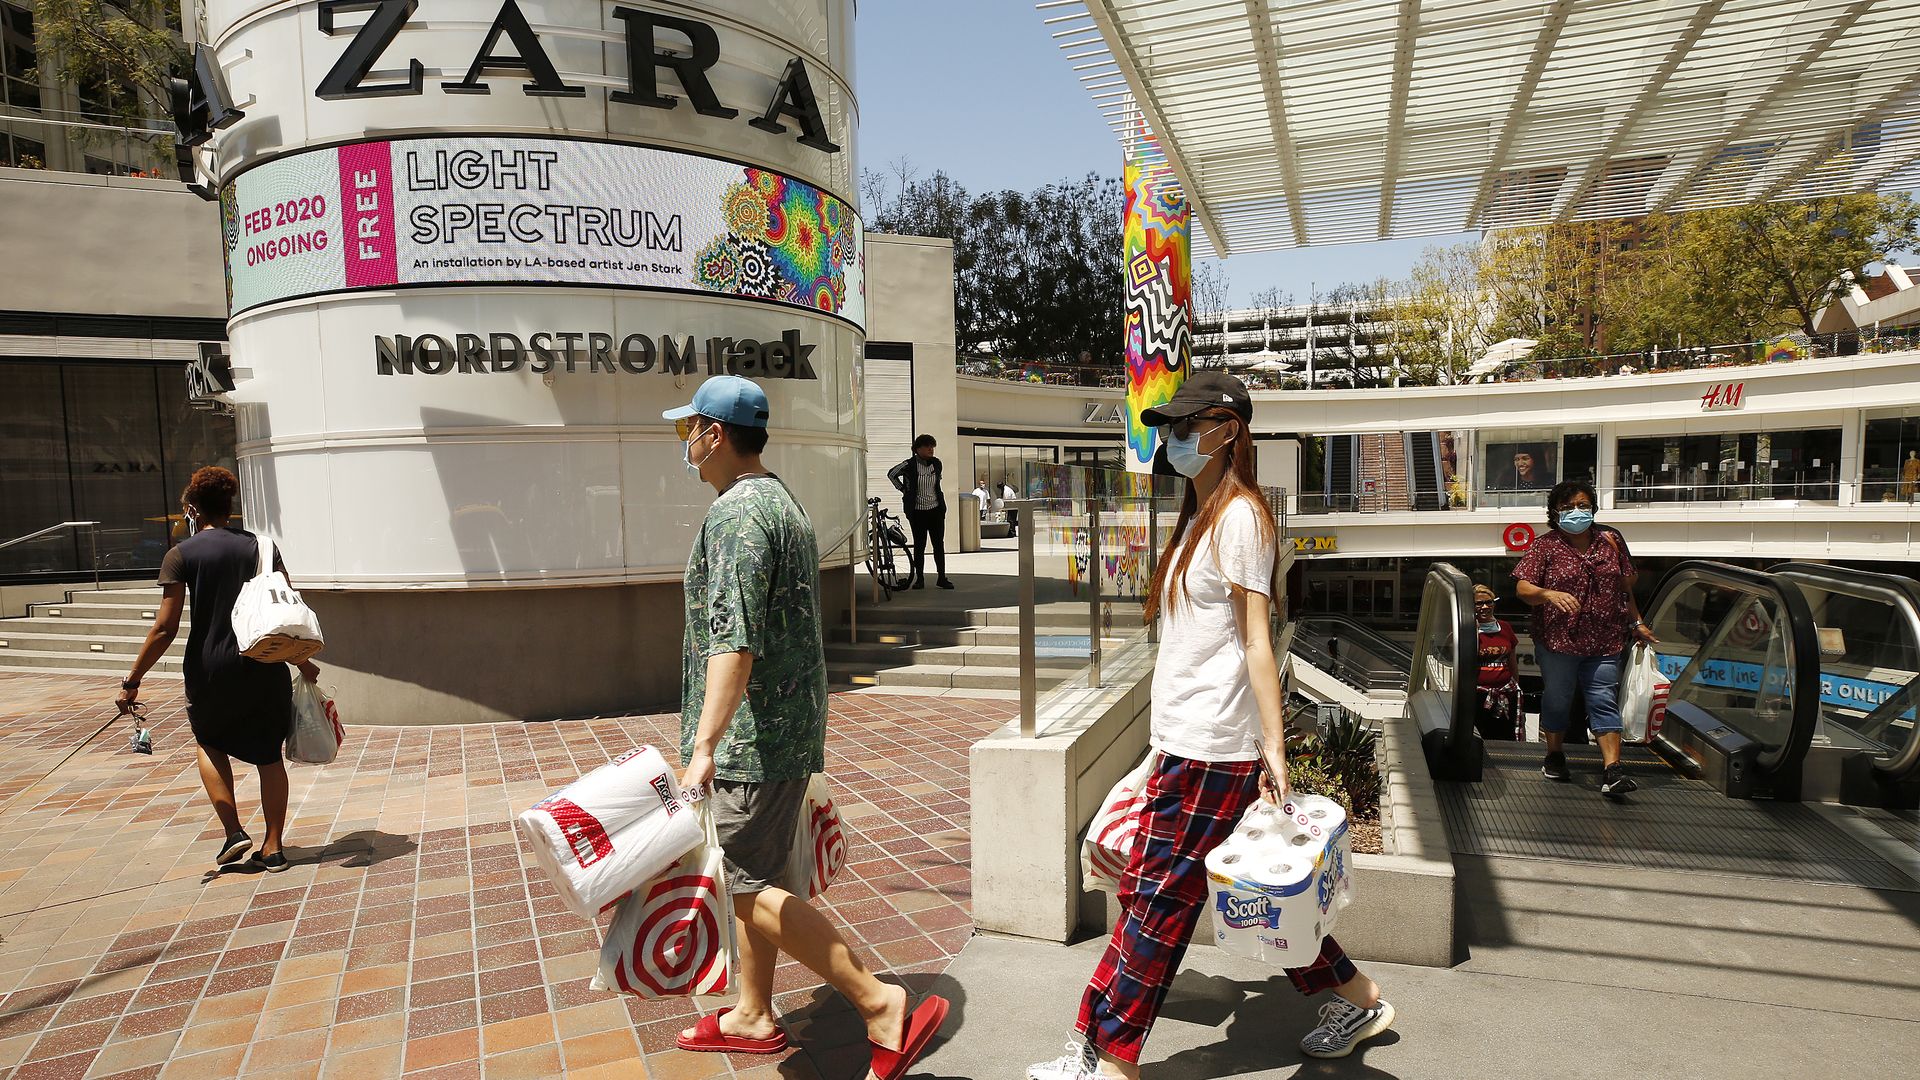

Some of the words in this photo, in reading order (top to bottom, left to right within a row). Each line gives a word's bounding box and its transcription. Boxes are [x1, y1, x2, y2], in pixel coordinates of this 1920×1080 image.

[315, 0, 840, 153] ZARA
[407, 149, 558, 192] LIGHT
[244, 211, 272, 237] FEB
[275, 195, 326, 227] 2020
[354, 168, 382, 261] FREE
[409, 203, 683, 253] SPECTRUM
[246, 229, 328, 267] ONGOING
[413, 257, 429, 268] An
[432, 256, 502, 268] installation
[506, 257, 522, 269] by
[525, 257, 586, 269] LA-based
[589, 259, 624, 271] artist
[626, 261, 648, 273] Jen
[651, 262, 683, 275] Stark
[374, 331, 699, 376] NORDSTROM
[706, 329, 818, 380] rack
[1700, 382, 1745, 409] H&M
[1700, 666, 1726, 681] the
[1731, 668, 1759, 684] line
[655, 776, 680, 813] TACKLE
[1225, 895, 1269, 919] Scott
[1240, 917, 1259, 927] 1000
